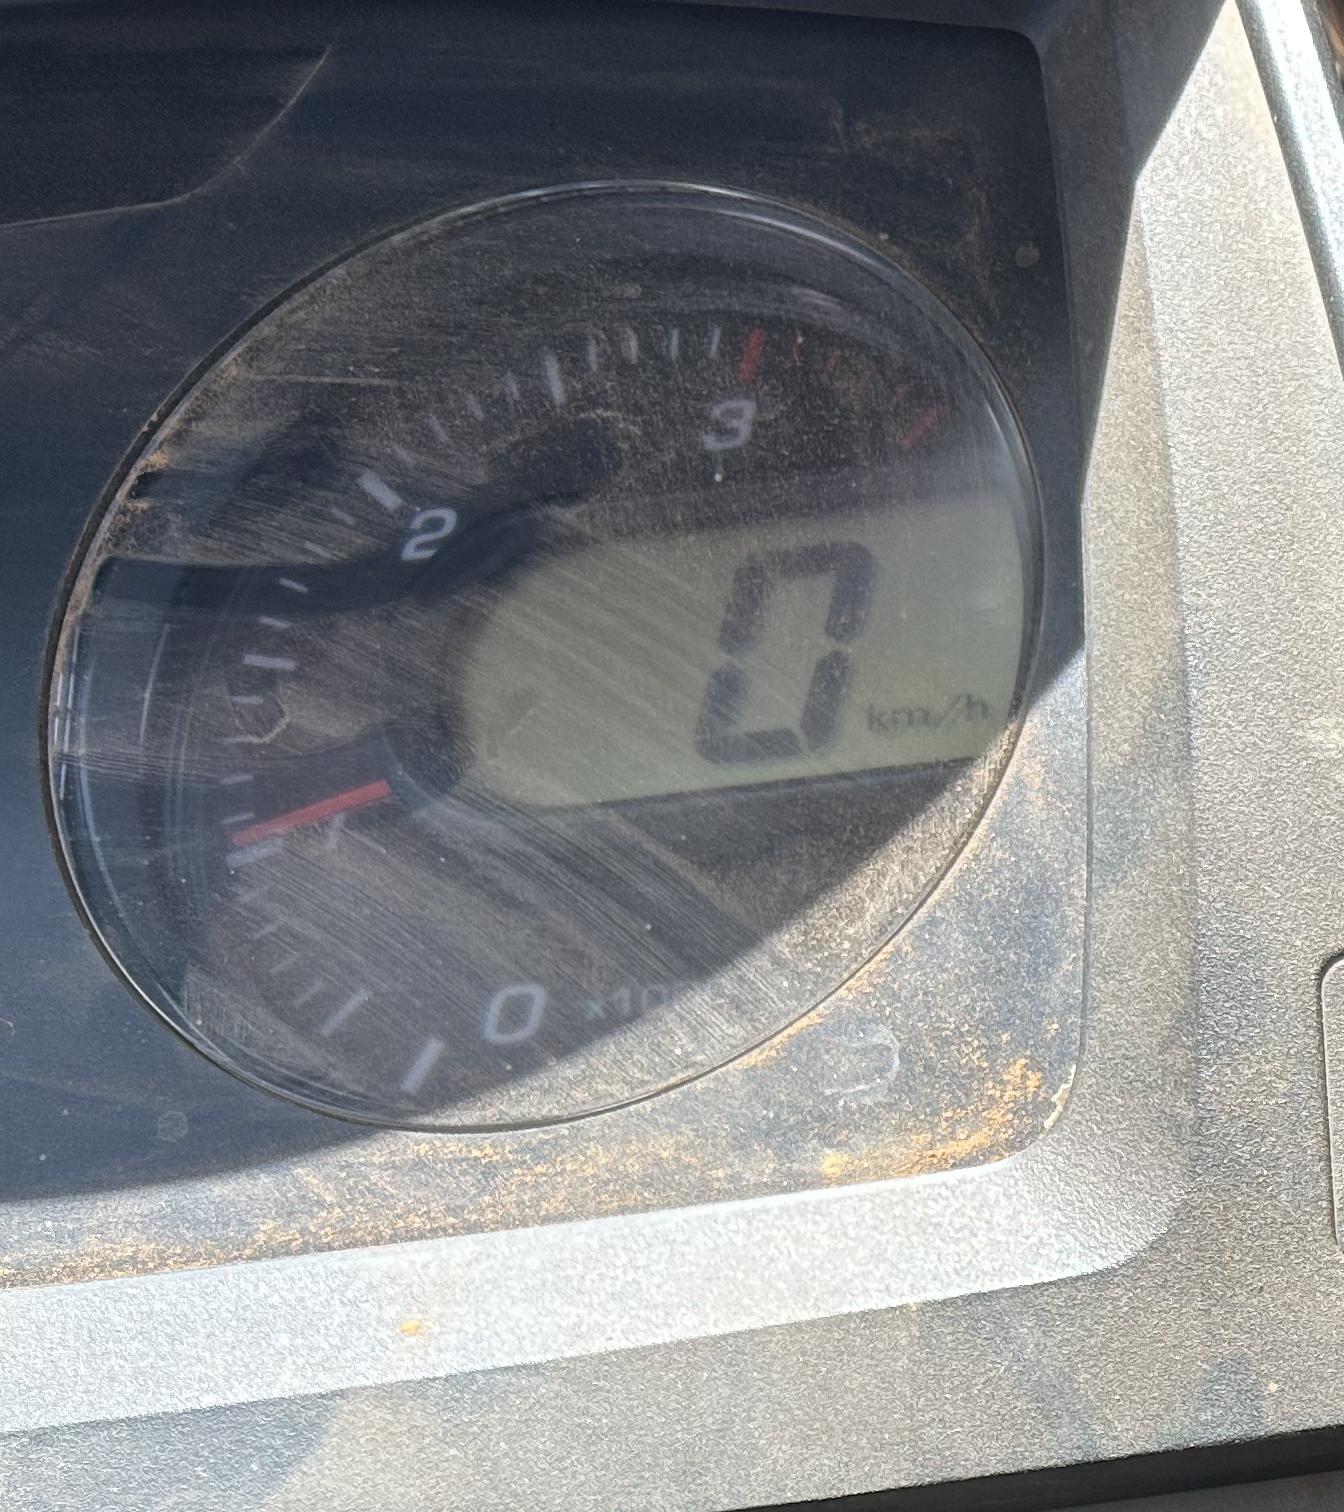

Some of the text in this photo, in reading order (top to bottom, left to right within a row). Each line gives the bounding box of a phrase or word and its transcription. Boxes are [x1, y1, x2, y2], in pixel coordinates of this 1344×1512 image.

[703, 398, 756, 451] 3
[401, 507, 458, 561] 2
[695, 540, 878, 765] 0
[867, 692, 988, 734] km/h
[483, 984, 546, 1043] 0
